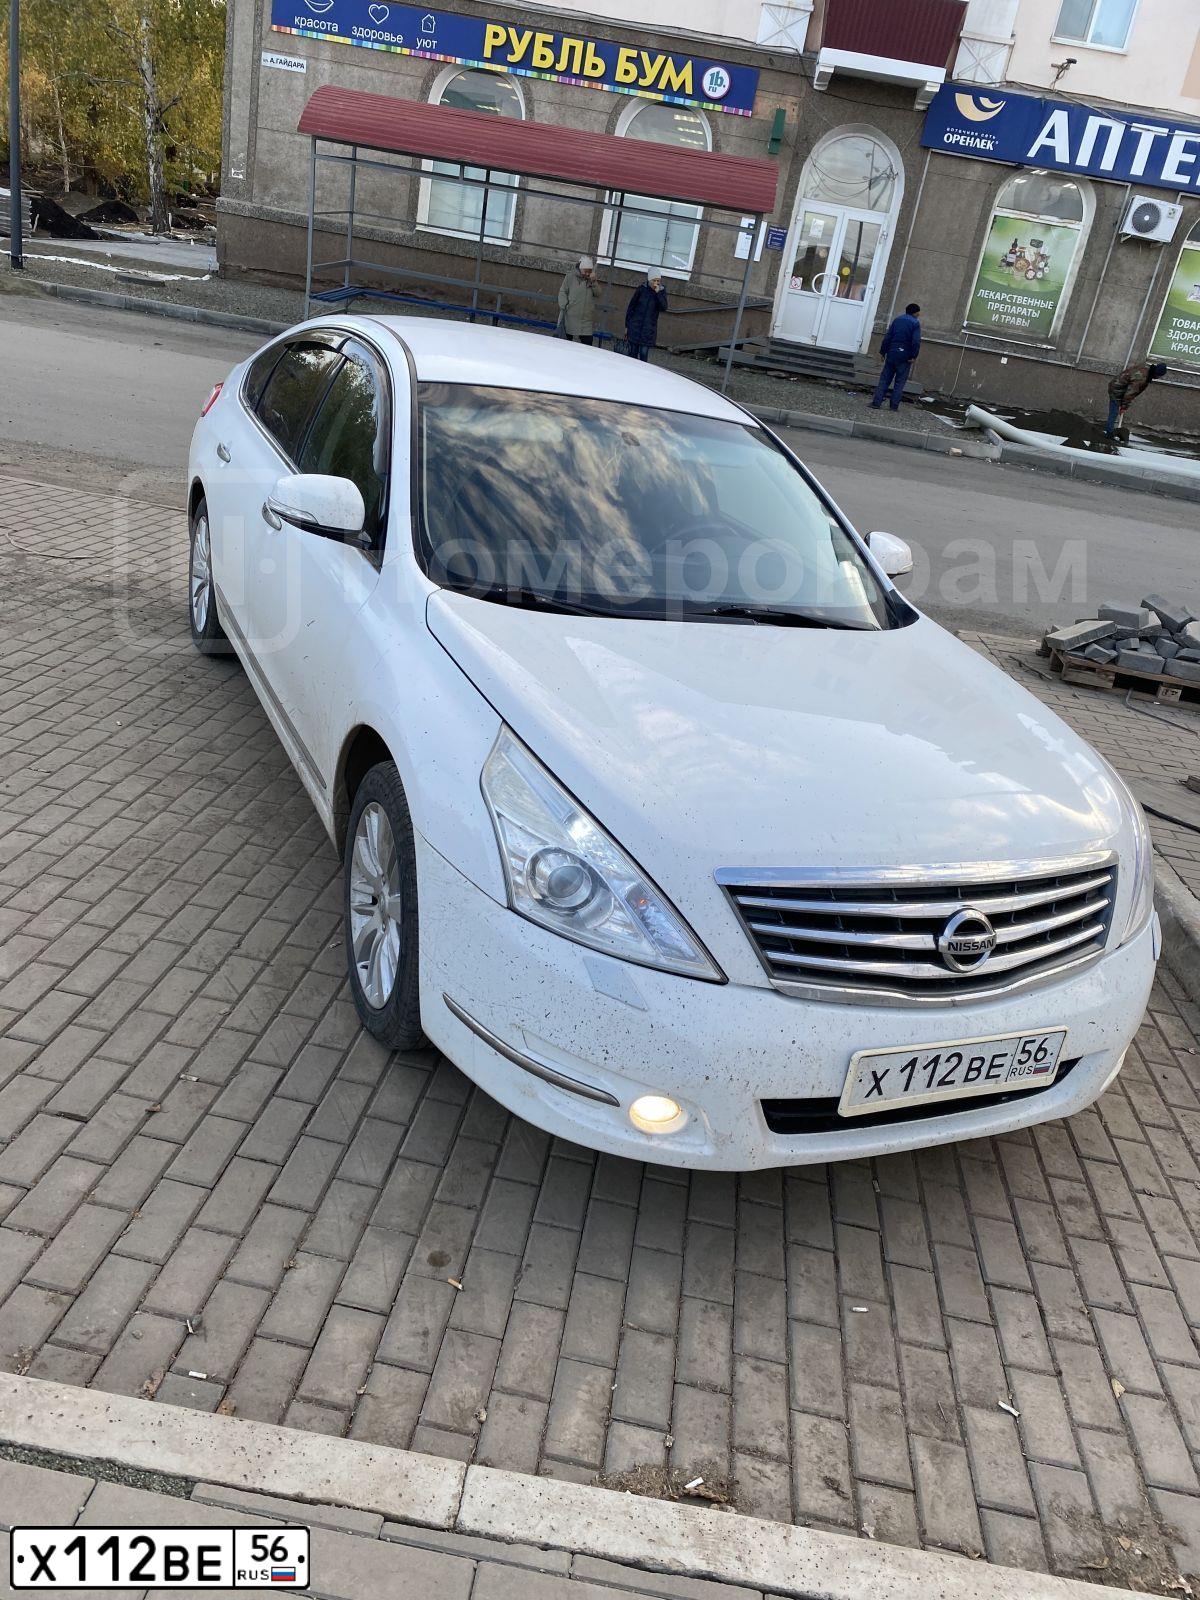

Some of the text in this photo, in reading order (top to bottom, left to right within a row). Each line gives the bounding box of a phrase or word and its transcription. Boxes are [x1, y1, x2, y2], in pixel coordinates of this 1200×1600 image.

[294, 15, 338, 32] красота
[351, 25, 403, 44] здоровье
[416, 37, 437, 49] уют
[483, 23, 693, 95] РУБЛЬ БУМ
[943, 132, 994, 151] ОРЕНЛЕК
[1026, 109, 1200, 186] АПТЕ
[977, 289, 1054, 310] ЛЕКАРСТВЕННЫЕ
[987, 301, 1040, 318] ПРЕПАРАТЫ
[991, 313, 1030, 328] И ТРАВЫ
[947, 938, 994, 952] NISSAN
[1017, 1037, 1049, 1066] 56
[1010, 1065, 1034, 1078] RUS
